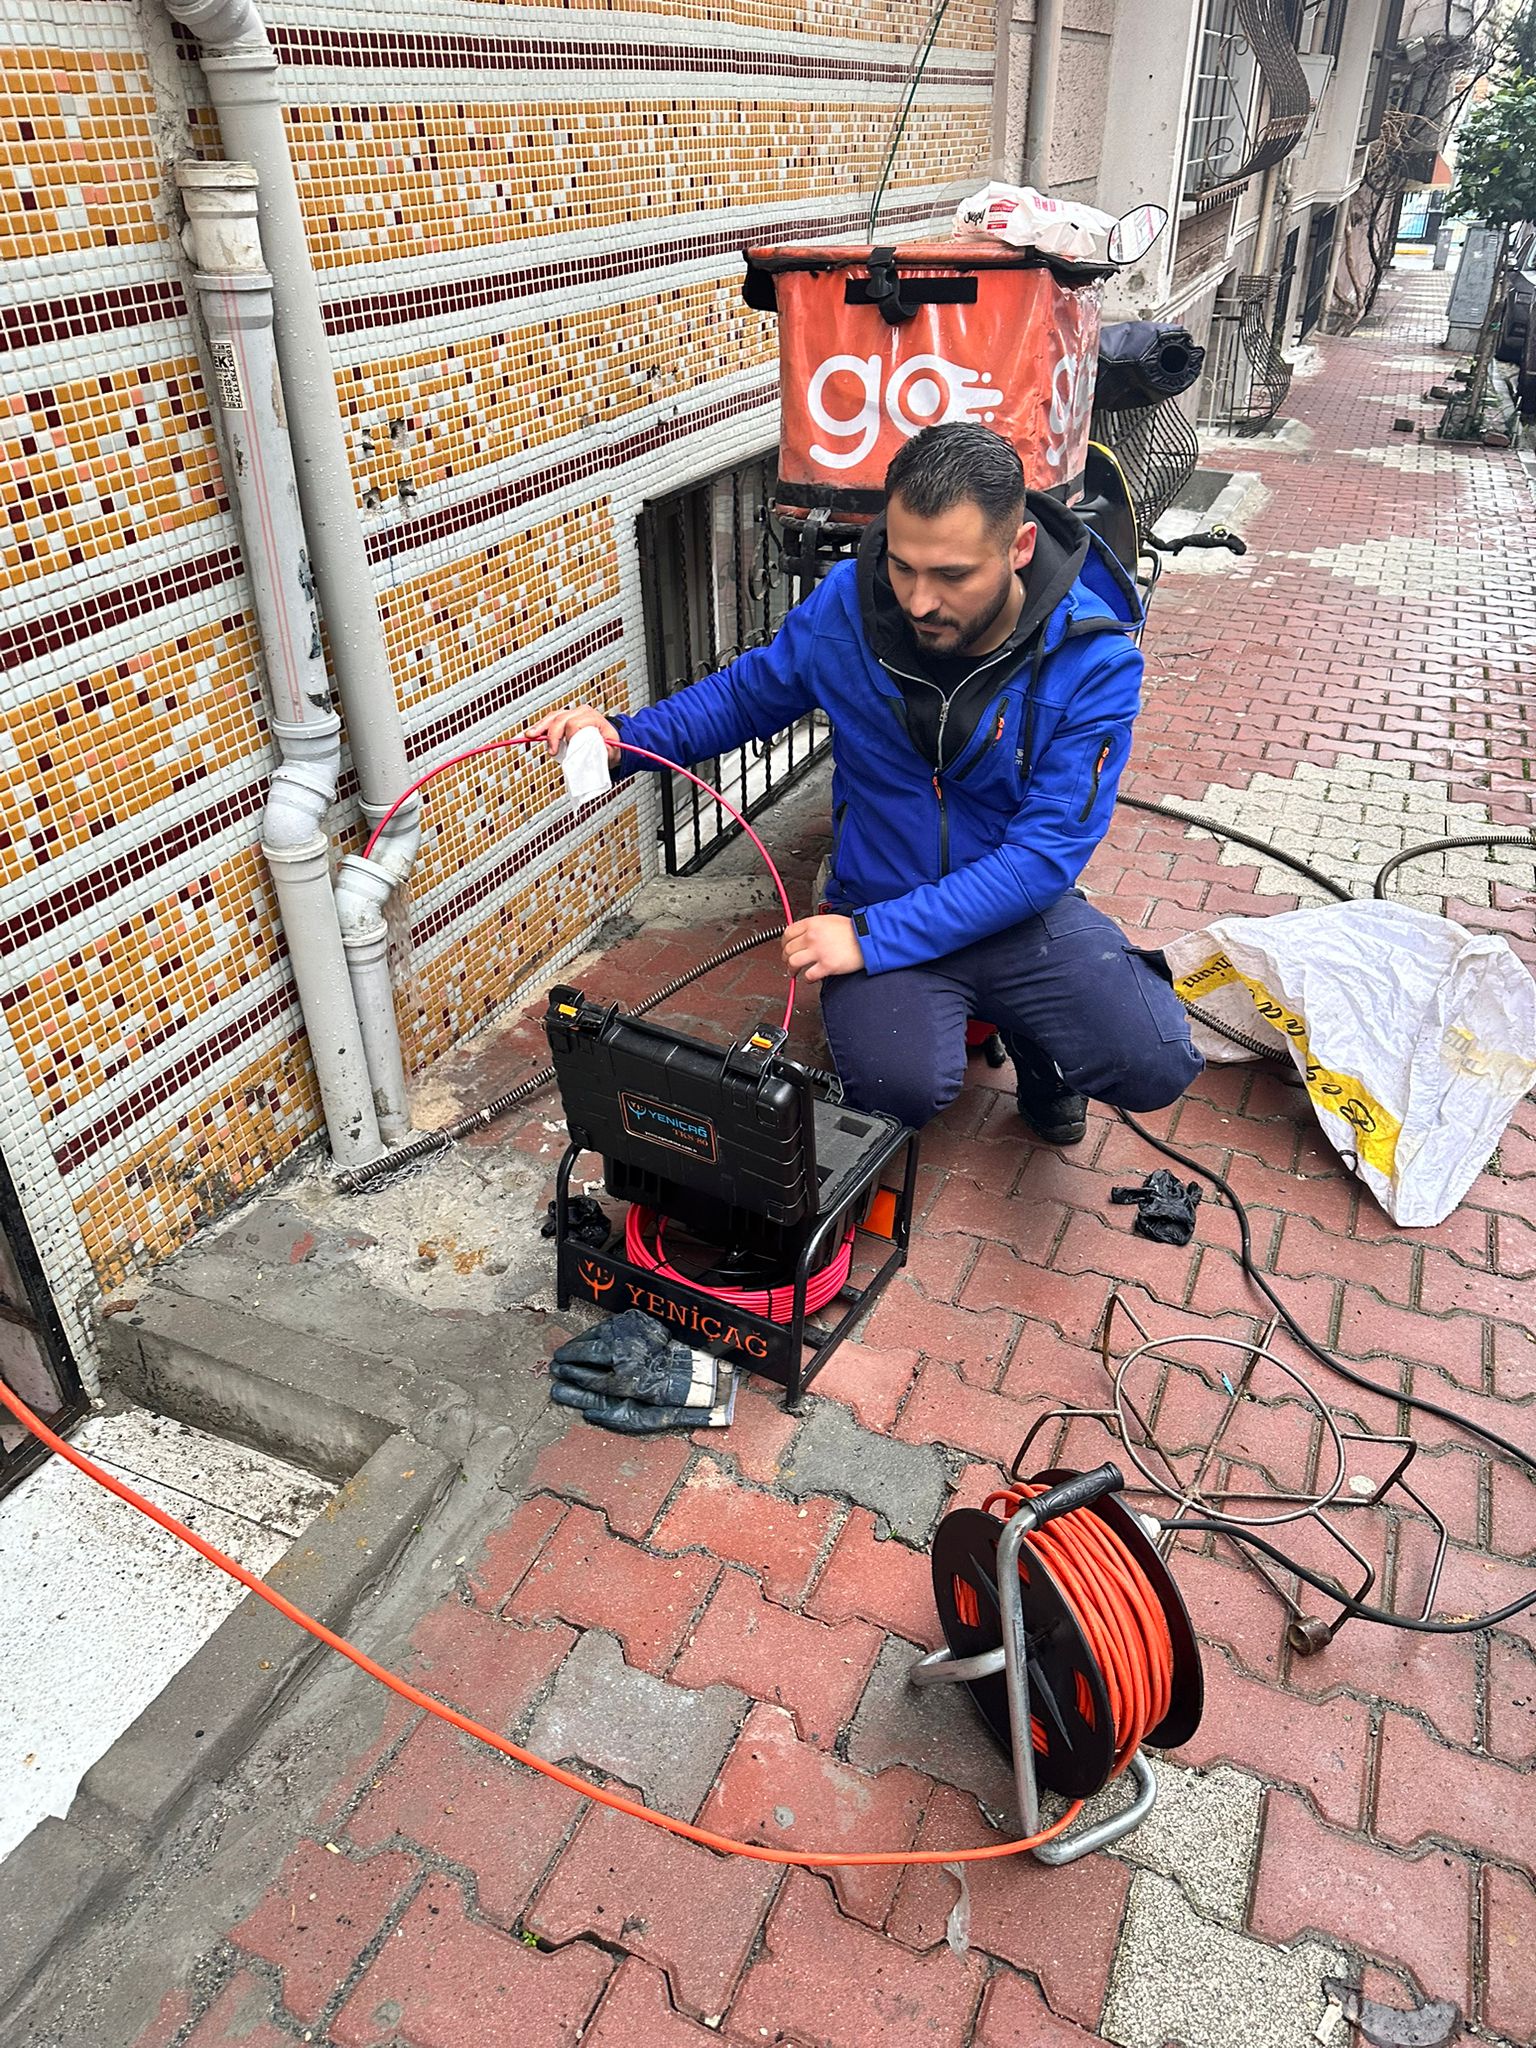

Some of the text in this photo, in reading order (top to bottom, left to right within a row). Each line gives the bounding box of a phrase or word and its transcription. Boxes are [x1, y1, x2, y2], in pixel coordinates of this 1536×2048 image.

[807, 353, 963, 469] go
[648, 1109, 707, 1138] YENİÇAĞ
[625, 1282, 768, 1358] YENİÇAĞ
